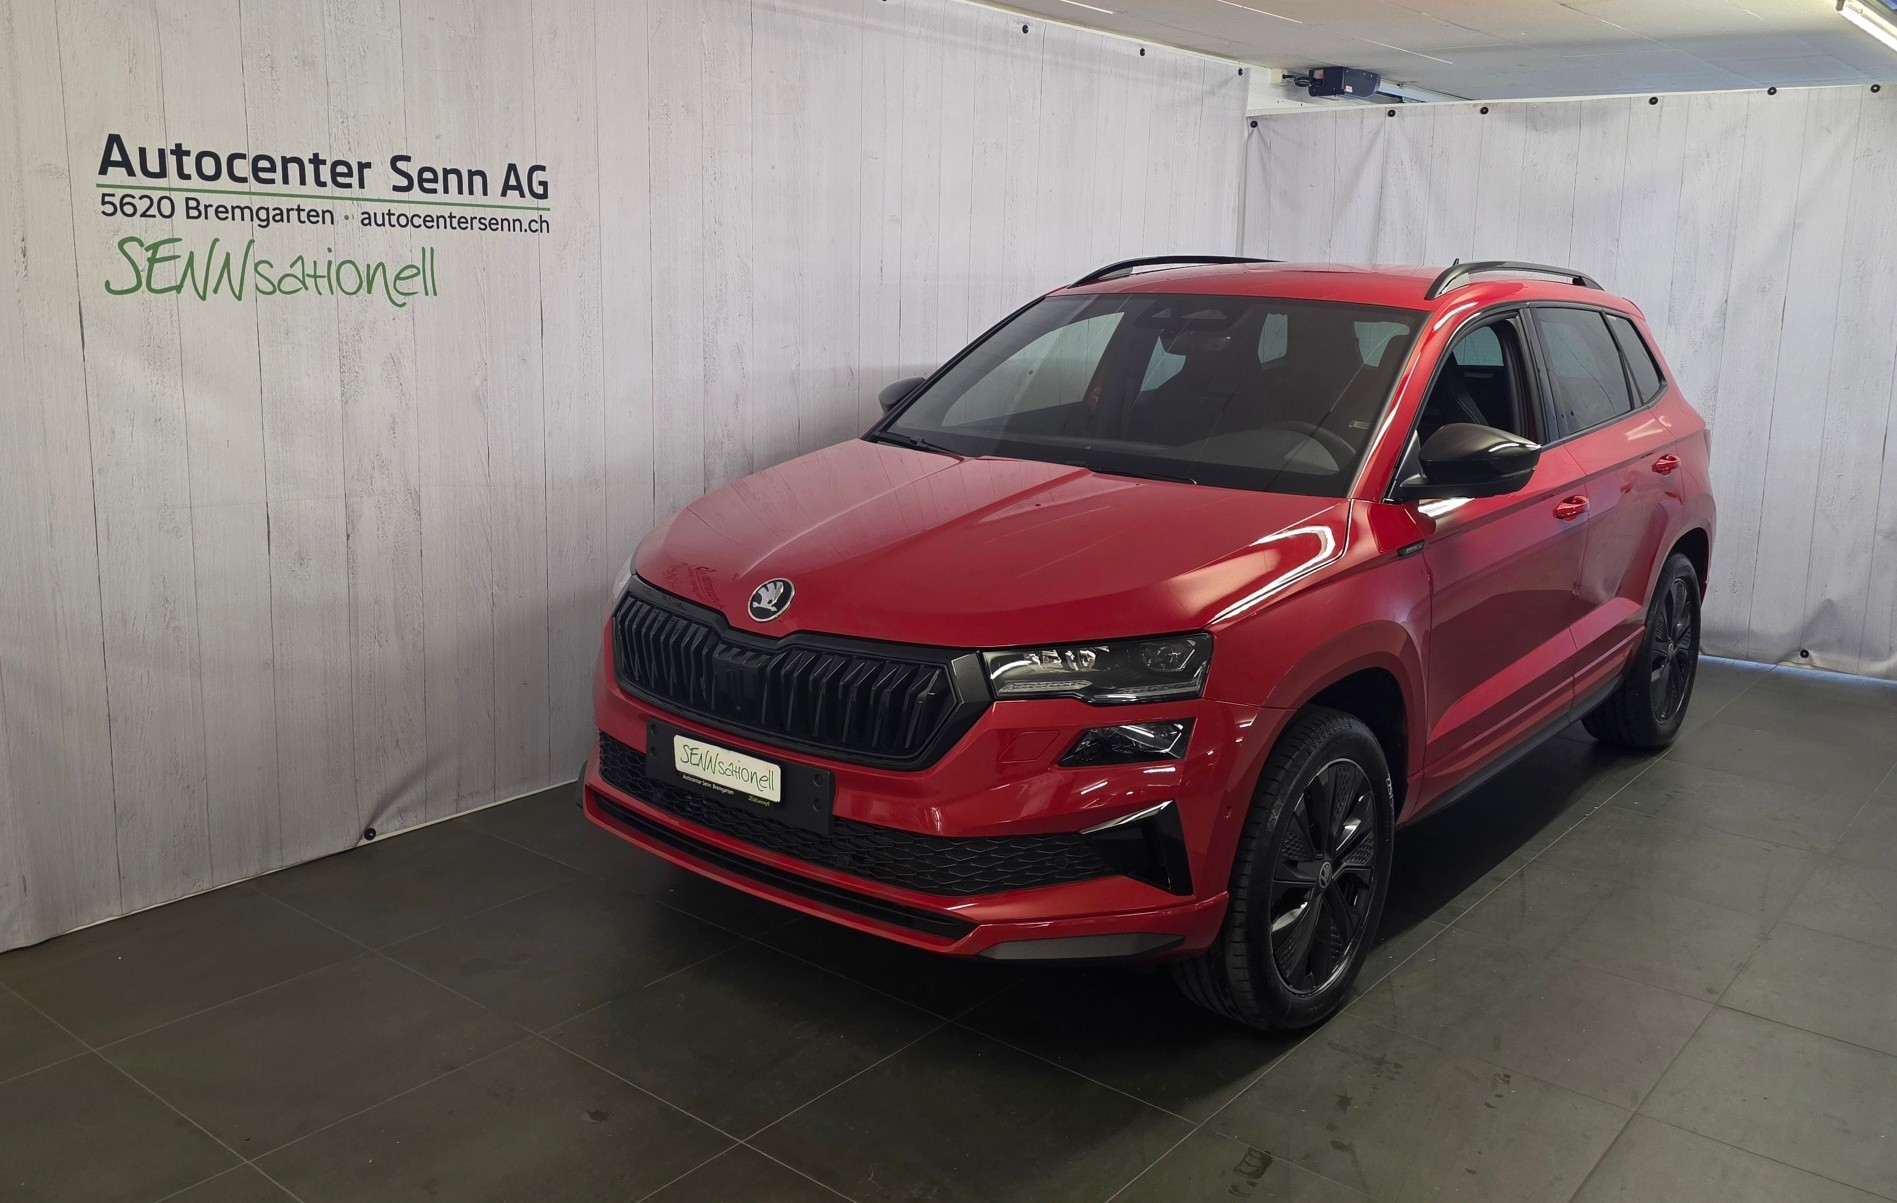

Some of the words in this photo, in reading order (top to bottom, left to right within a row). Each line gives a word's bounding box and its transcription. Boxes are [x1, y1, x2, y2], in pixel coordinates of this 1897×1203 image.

[98, 133, 372, 190] Autocenter
[389, 154, 488, 197] Senn
[500, 163, 549, 200] AG
[100, 192, 175, 219] 5620
[185, 196, 335, 228] Bremgarten
[360, 208, 550, 234] autocentersenn.ch
[105, 236, 437, 307] SENNsationell
[680, 744, 774, 792] SENNsationell
